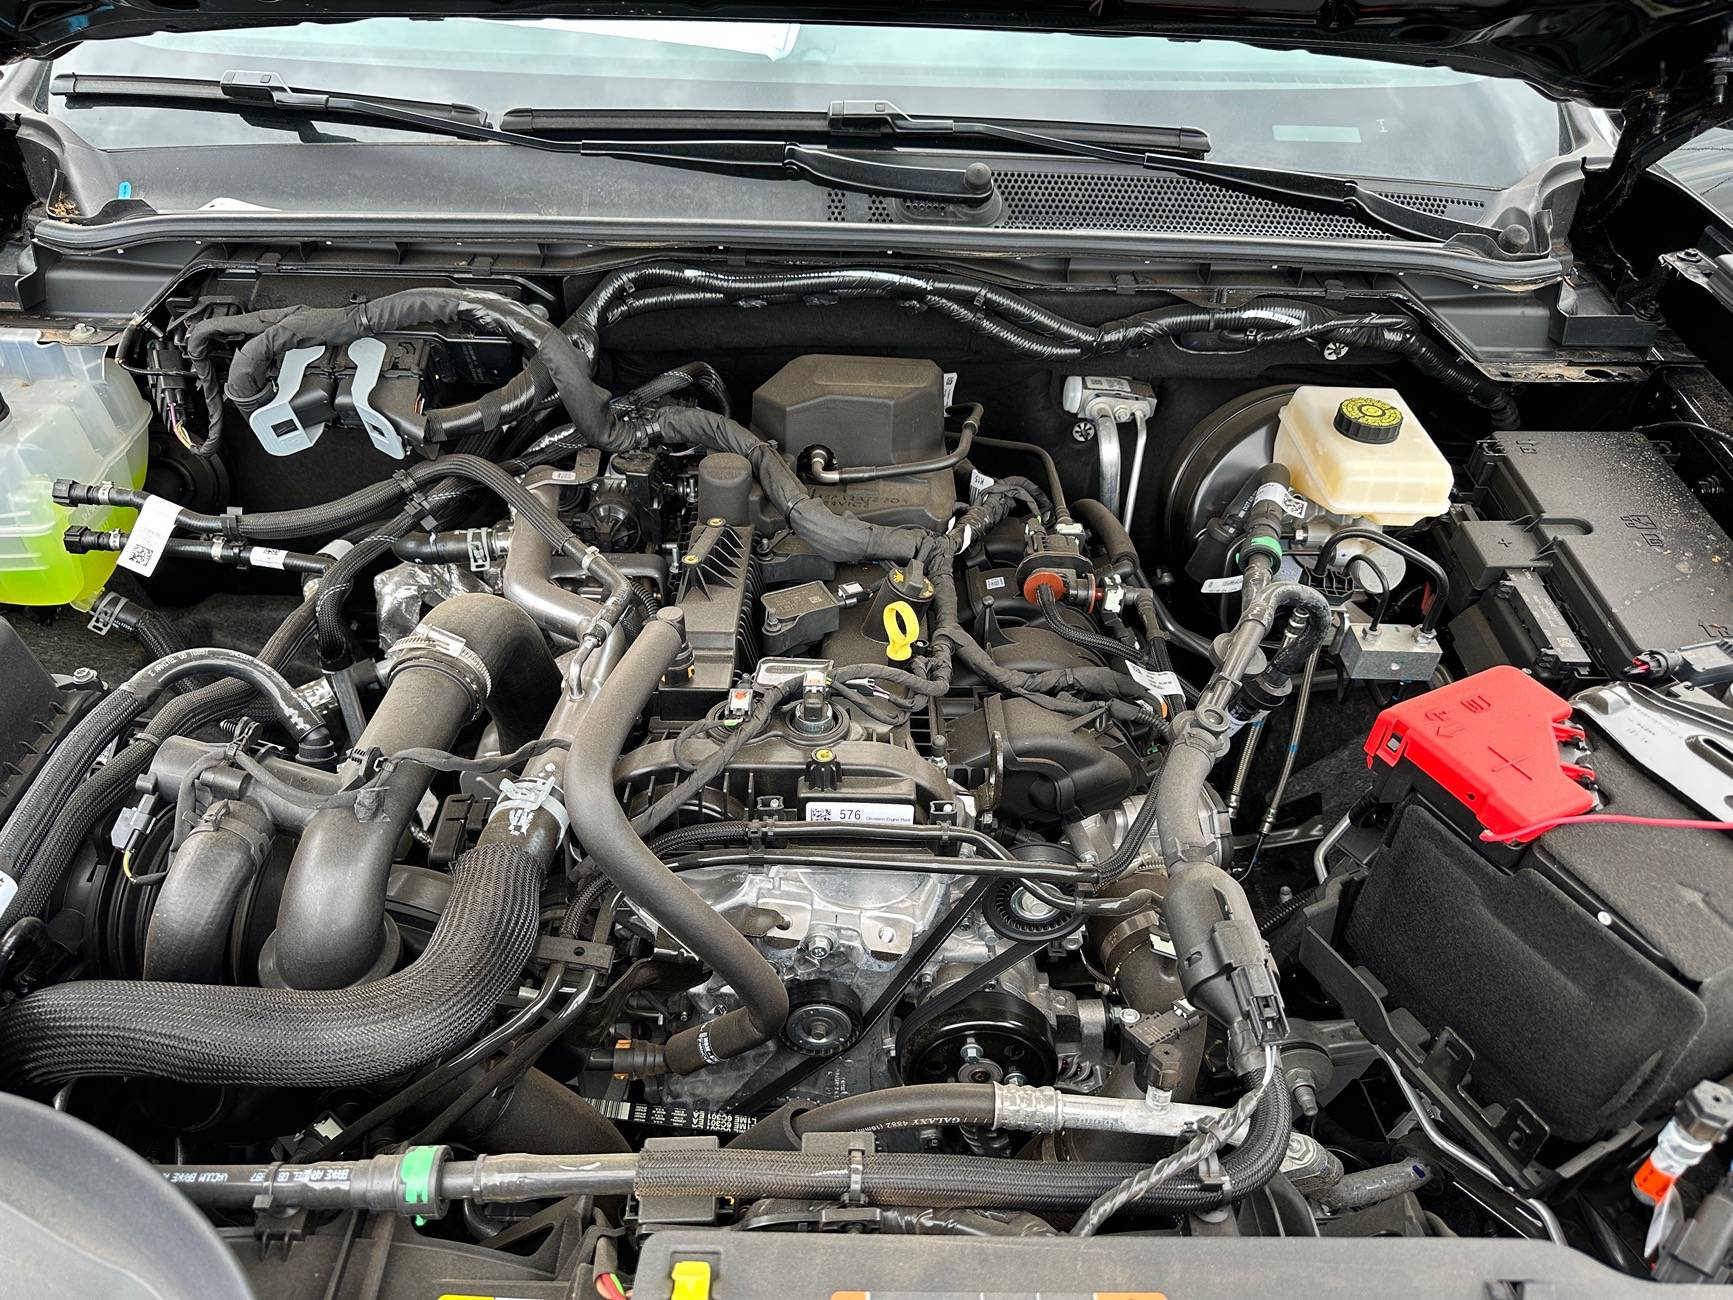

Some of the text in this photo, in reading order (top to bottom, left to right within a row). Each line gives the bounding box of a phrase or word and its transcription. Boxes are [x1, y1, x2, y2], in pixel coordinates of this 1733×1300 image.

[839, 809, 861, 820] 576
[911, 1117, 960, 1125] GALAXY
[198, 1172, 228, 1183] VACUUM
